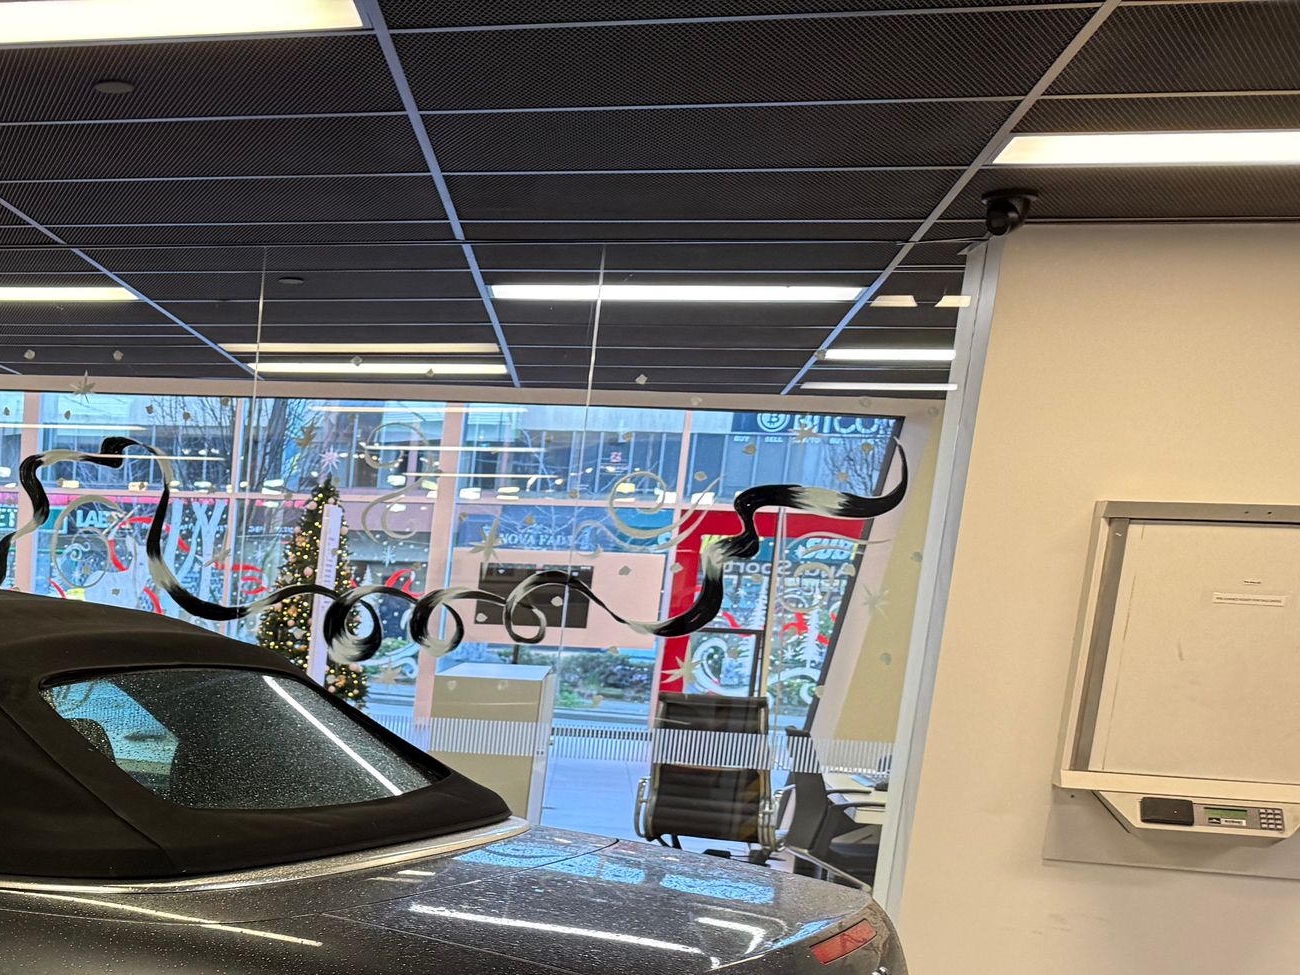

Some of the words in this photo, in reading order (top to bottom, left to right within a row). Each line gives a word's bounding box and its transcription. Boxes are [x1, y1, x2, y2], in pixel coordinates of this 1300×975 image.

[793, 413, 896, 434] BITCO
[500, 533, 537, 545] NOVA
[802, 538, 858, 560] SUB
